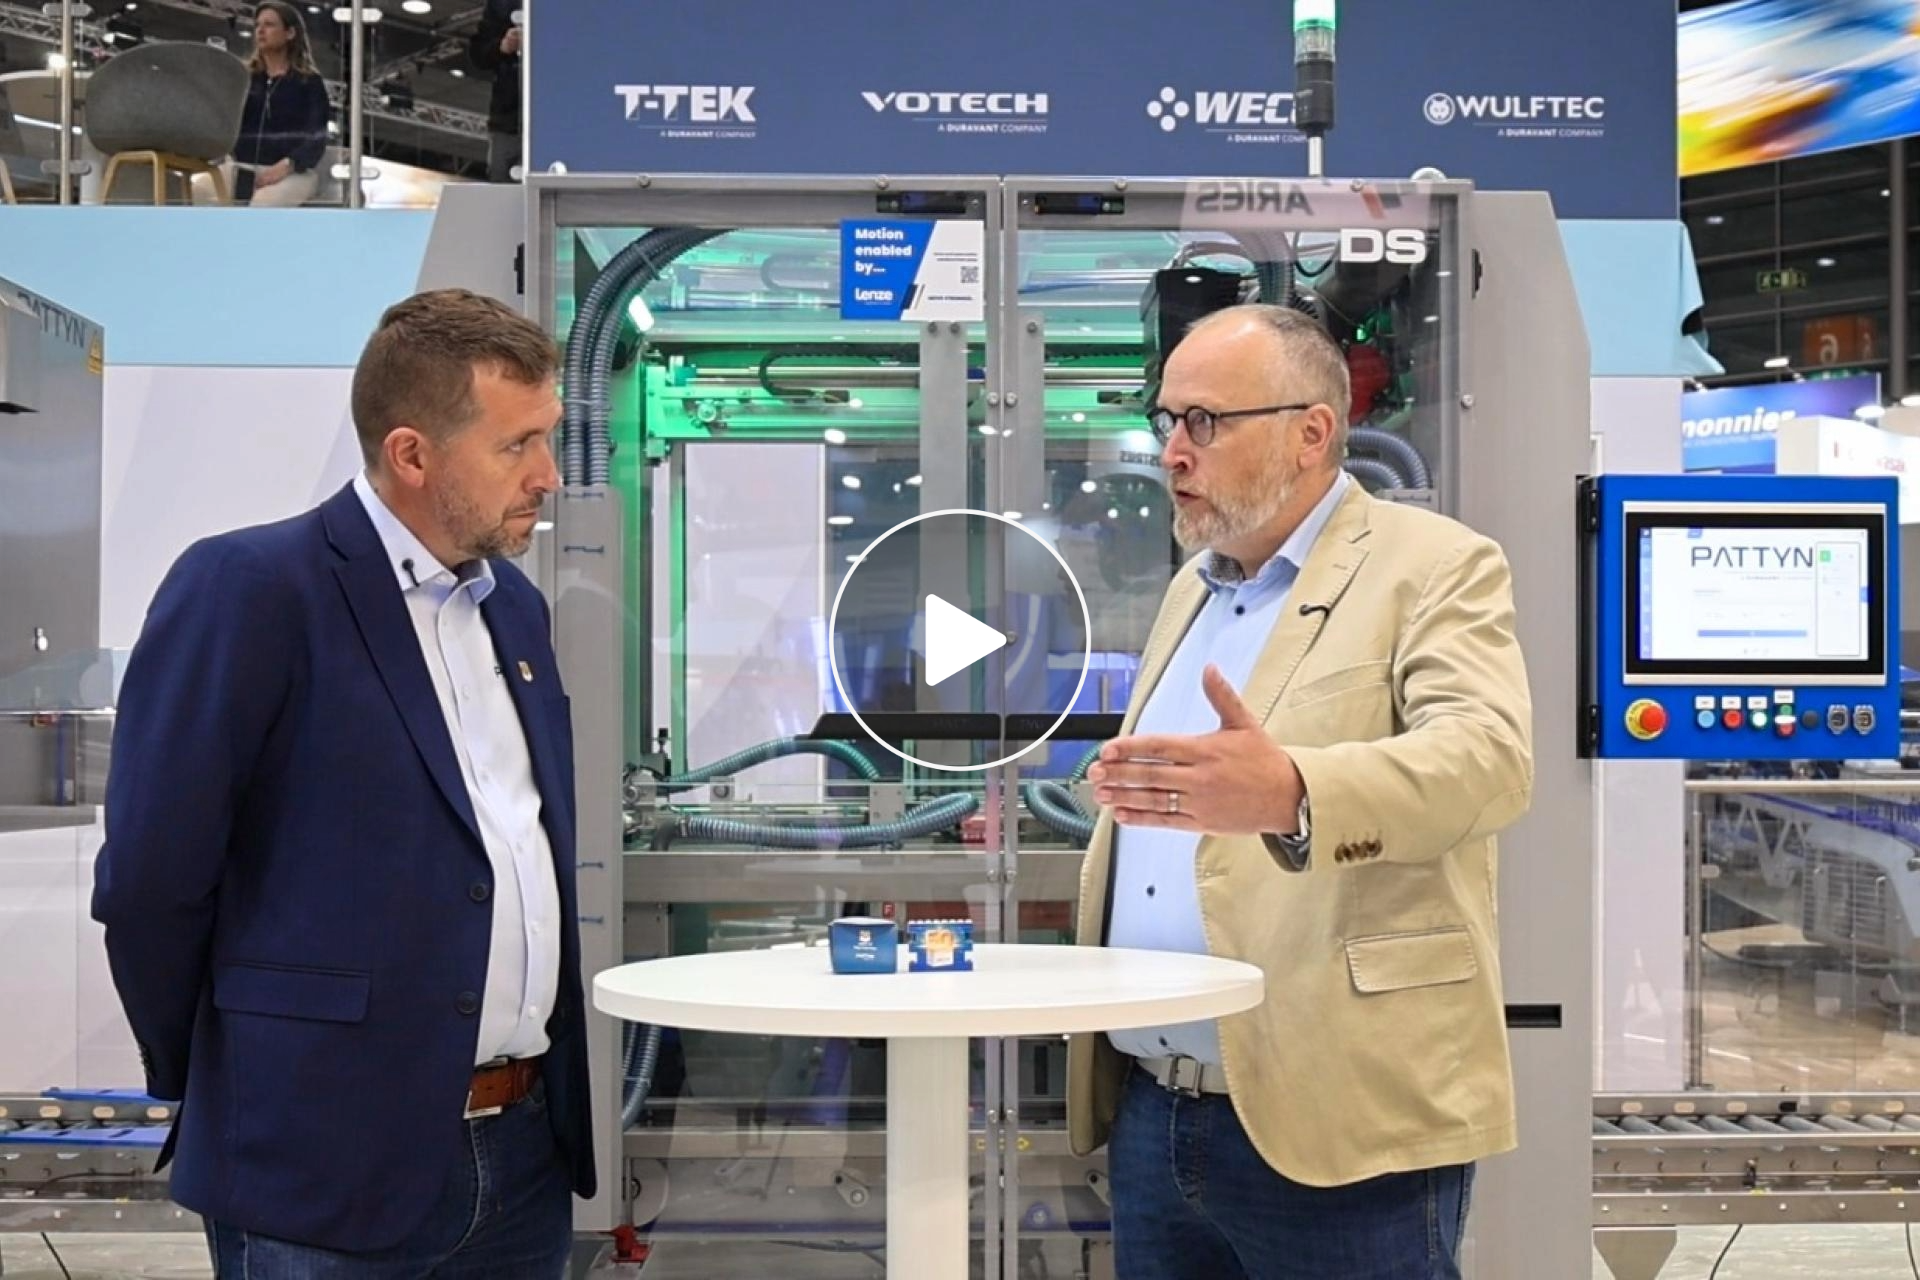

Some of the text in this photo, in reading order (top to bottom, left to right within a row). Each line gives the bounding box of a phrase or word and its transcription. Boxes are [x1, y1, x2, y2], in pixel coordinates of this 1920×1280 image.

[614, 84, 756, 122] T-TEK
[861, 91, 1048, 113] VOTECH
[1195, 91, 1297, 123] WEC
[1455, 95, 1605, 118] WULFTEC
[947, 123, 999, 133] DURAVANT
[1000, 123, 1048, 133] COMPANY
[1506, 128, 1557, 137] DURAVANT
[1558, 128, 1604, 137] COMPANY
[1281, 134, 1307, 142] COMP
[854, 227, 904, 240] Motion
[854, 244, 913, 257] enabled
[1340, 228, 1427, 263] DS
[854, 260, 886, 276] by...
[854, 287, 894, 301] Lenze
[1690, 545, 1813, 568] PATTYN
